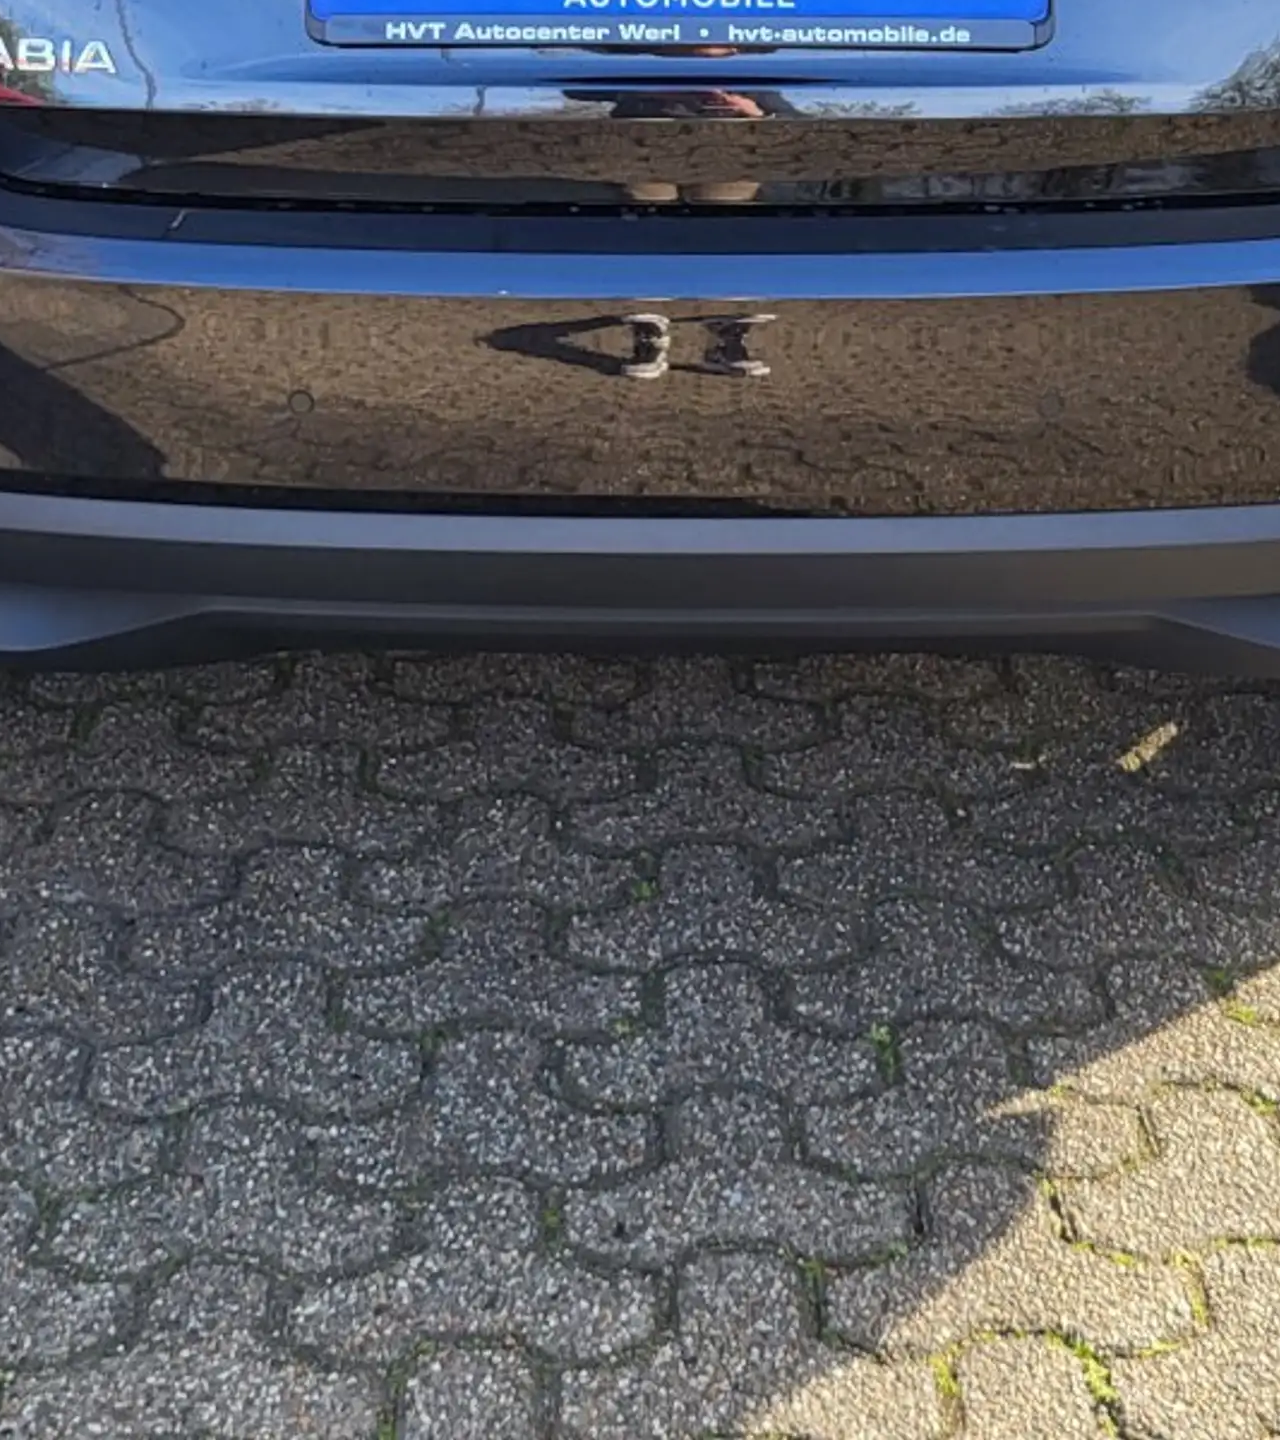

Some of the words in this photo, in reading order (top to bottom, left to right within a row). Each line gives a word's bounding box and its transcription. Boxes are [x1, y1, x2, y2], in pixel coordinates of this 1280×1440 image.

[385, 21, 446, 40] HVT
[453, 22, 610, 41] Autocenter
[618, 23, 680, 41] Werl
[728, 23, 971, 44] hvt-automobile.de
